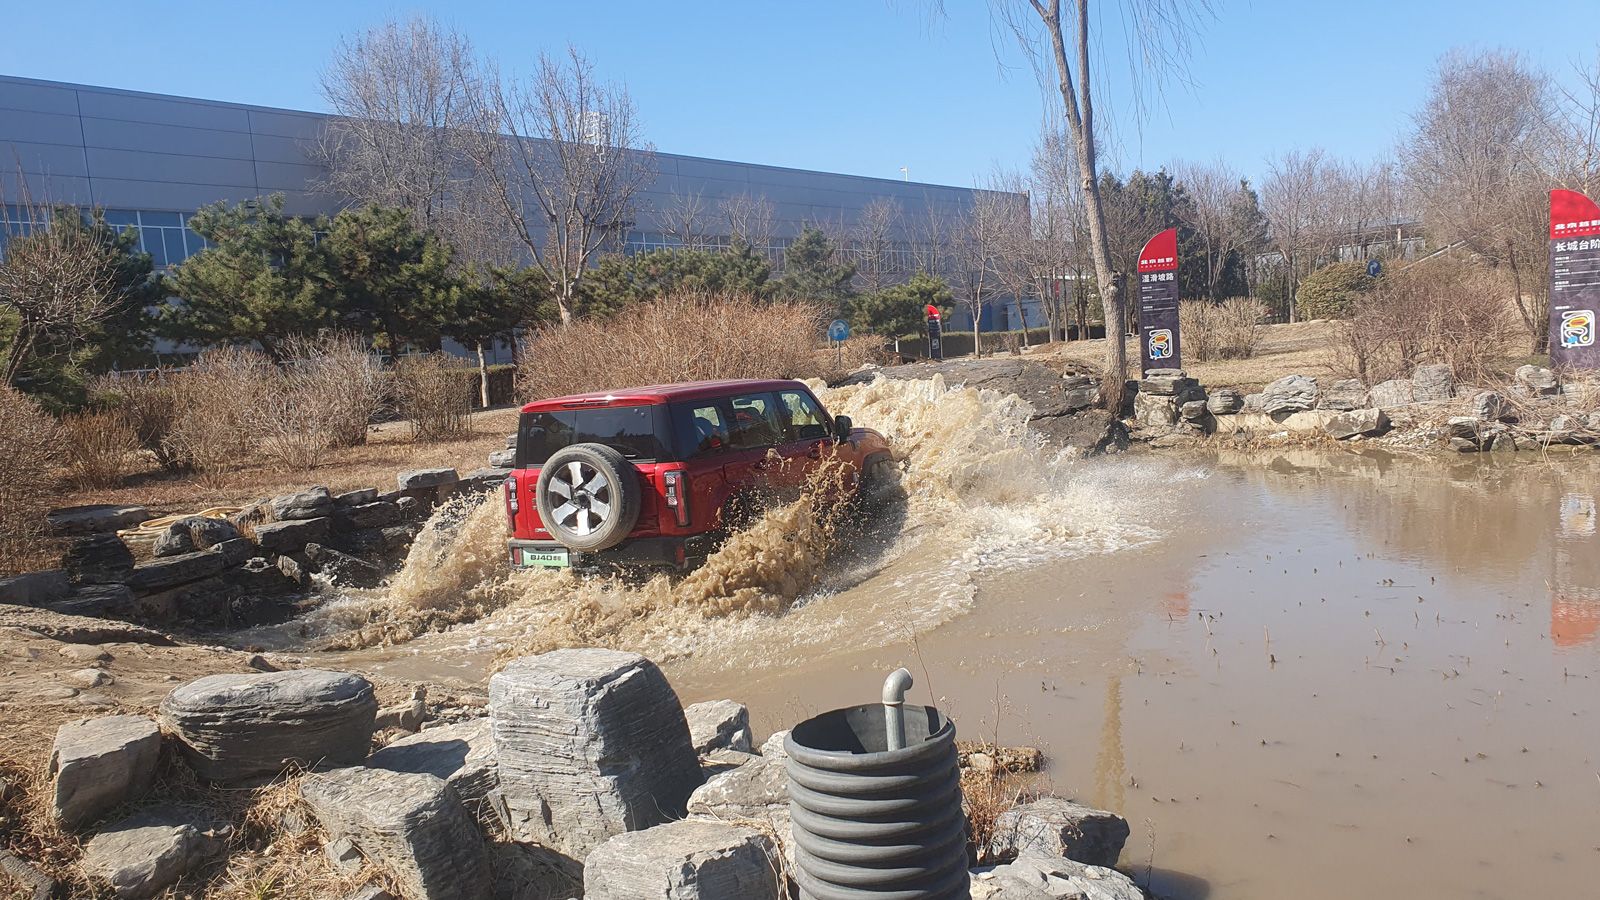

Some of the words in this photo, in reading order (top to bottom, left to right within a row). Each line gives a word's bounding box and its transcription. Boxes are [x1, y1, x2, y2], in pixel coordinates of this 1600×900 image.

[1555, 238, 1600, 252] 长城台阶
[1141, 272, 1174, 283] 湿滑坡路
